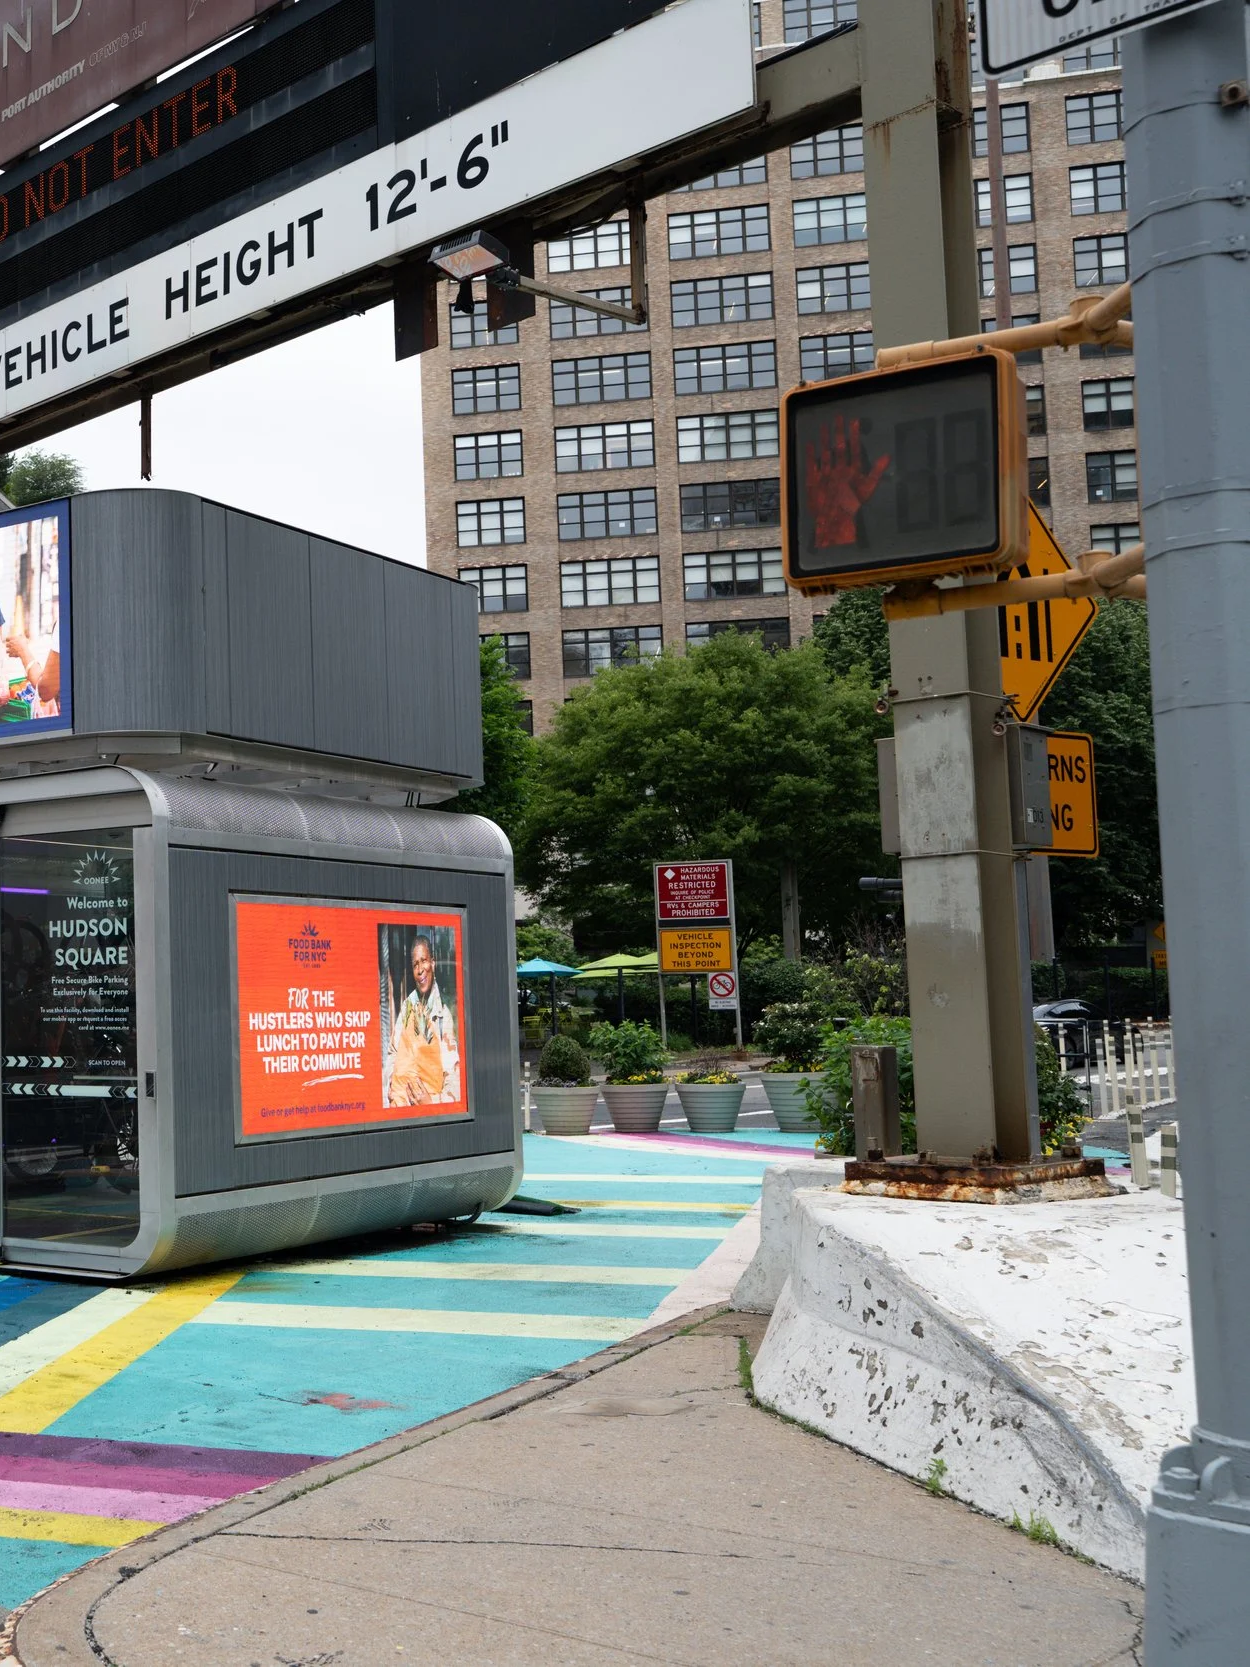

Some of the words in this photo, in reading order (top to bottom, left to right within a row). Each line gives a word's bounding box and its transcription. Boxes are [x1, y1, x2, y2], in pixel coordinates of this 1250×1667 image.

[1058, 26, 1094, 43] DEPT
[1110, 13, 1127, 25] OF
[1, 95, 28, 125] PORT
[28, 59, 86, 106] AUTHORITY
[89, 48, 105, 67] OF
[104, 37, 121, 60] NY
[132, 21, 148, 43] NJ
[24, 145, 94, 228] NOT
[113, 66, 238, 180] ENTER
[165, 208, 324, 320] HEIGHT
[365, 120, 509, 232] 12'-6"
[84, 877, 109, 885] OONEE
[668, 880, 716, 889] RESTRICTED
[67, 897, 114, 909] Welcome
[117, 897, 128, 907] to
[687, 901, 720, 909] CAMPERS
[671, 908, 716, 917] PROHIBITED
[49, 917, 128, 938] HUDSON
[677, 933, 714, 941] VEHICLE
[288, 938, 310, 949] FOOD
[311, 940, 332, 950] BANK
[670, 942, 722, 950] INSPECTION
[55, 947, 128, 970] SQUARE
[294, 951, 310, 961] FOR
[311, 952, 327, 962] NYC
[678, 951, 714, 959] BEYOND
[672, 960, 692, 968] THIS
[695, 960, 721, 968] POINT
[51, 976, 65, 984] Free
[66, 976, 87, 984] Secure
[88, 976, 102, 984] Bike
[103, 975, 129, 986] Parking
[53, 988, 87, 998] Exclusively
[88, 988, 98, 996] for
[99, 987, 129, 998] Everyone
[288, 988, 309, 1009] FOR
[312, 991, 335, 1007] THE
[249, 1012, 314, 1030] HUSTLERS
[315, 1011, 343, 1028] WHO
[345, 1011, 371, 1028] SKIP
[257, 1034, 300, 1052] LUNCH
[301, 1034, 318, 1050] TO
[319, 1033, 341, 1049] PAY
[342, 1032, 366, 1048] FOR
[110, 1059, 126, 1067] OPEN
[262, 1056, 300, 1074] THEIR
[301, 1052, 361, 1072] COMMUTE
[261, 1108, 275, 1117] Give
[284, 1107, 295, 1117] get
[296, 1105, 309, 1115] help
[310, 1105, 317, 1113] at
[318, 1101, 366, 1111] foodbanknyc.org
